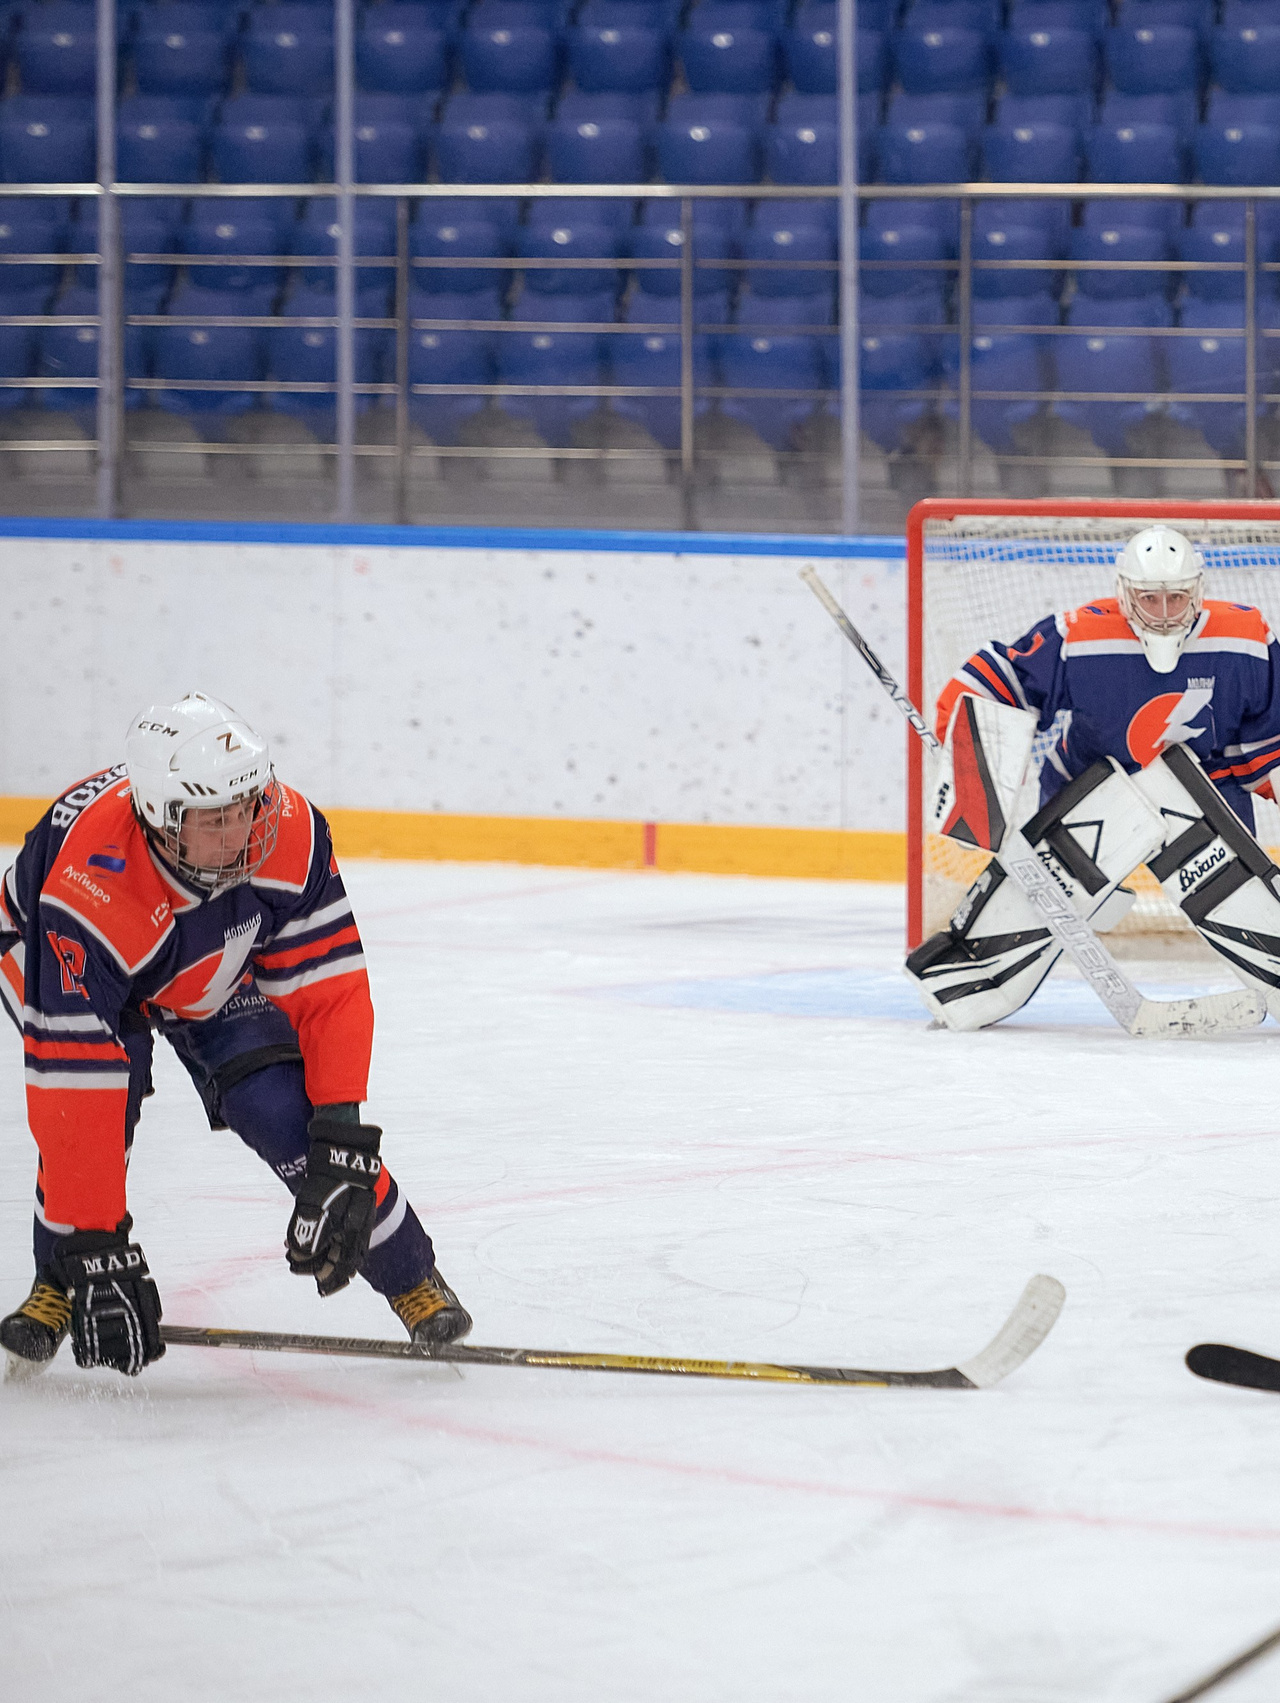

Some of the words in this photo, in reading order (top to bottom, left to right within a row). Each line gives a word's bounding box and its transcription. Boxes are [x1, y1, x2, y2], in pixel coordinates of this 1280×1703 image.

[138, 720, 179, 738] CCM
[229, 768, 259, 787] CCM
[1179, 845, 1227, 892] Brian's
[1008, 857, 1130, 1000] BAUER
